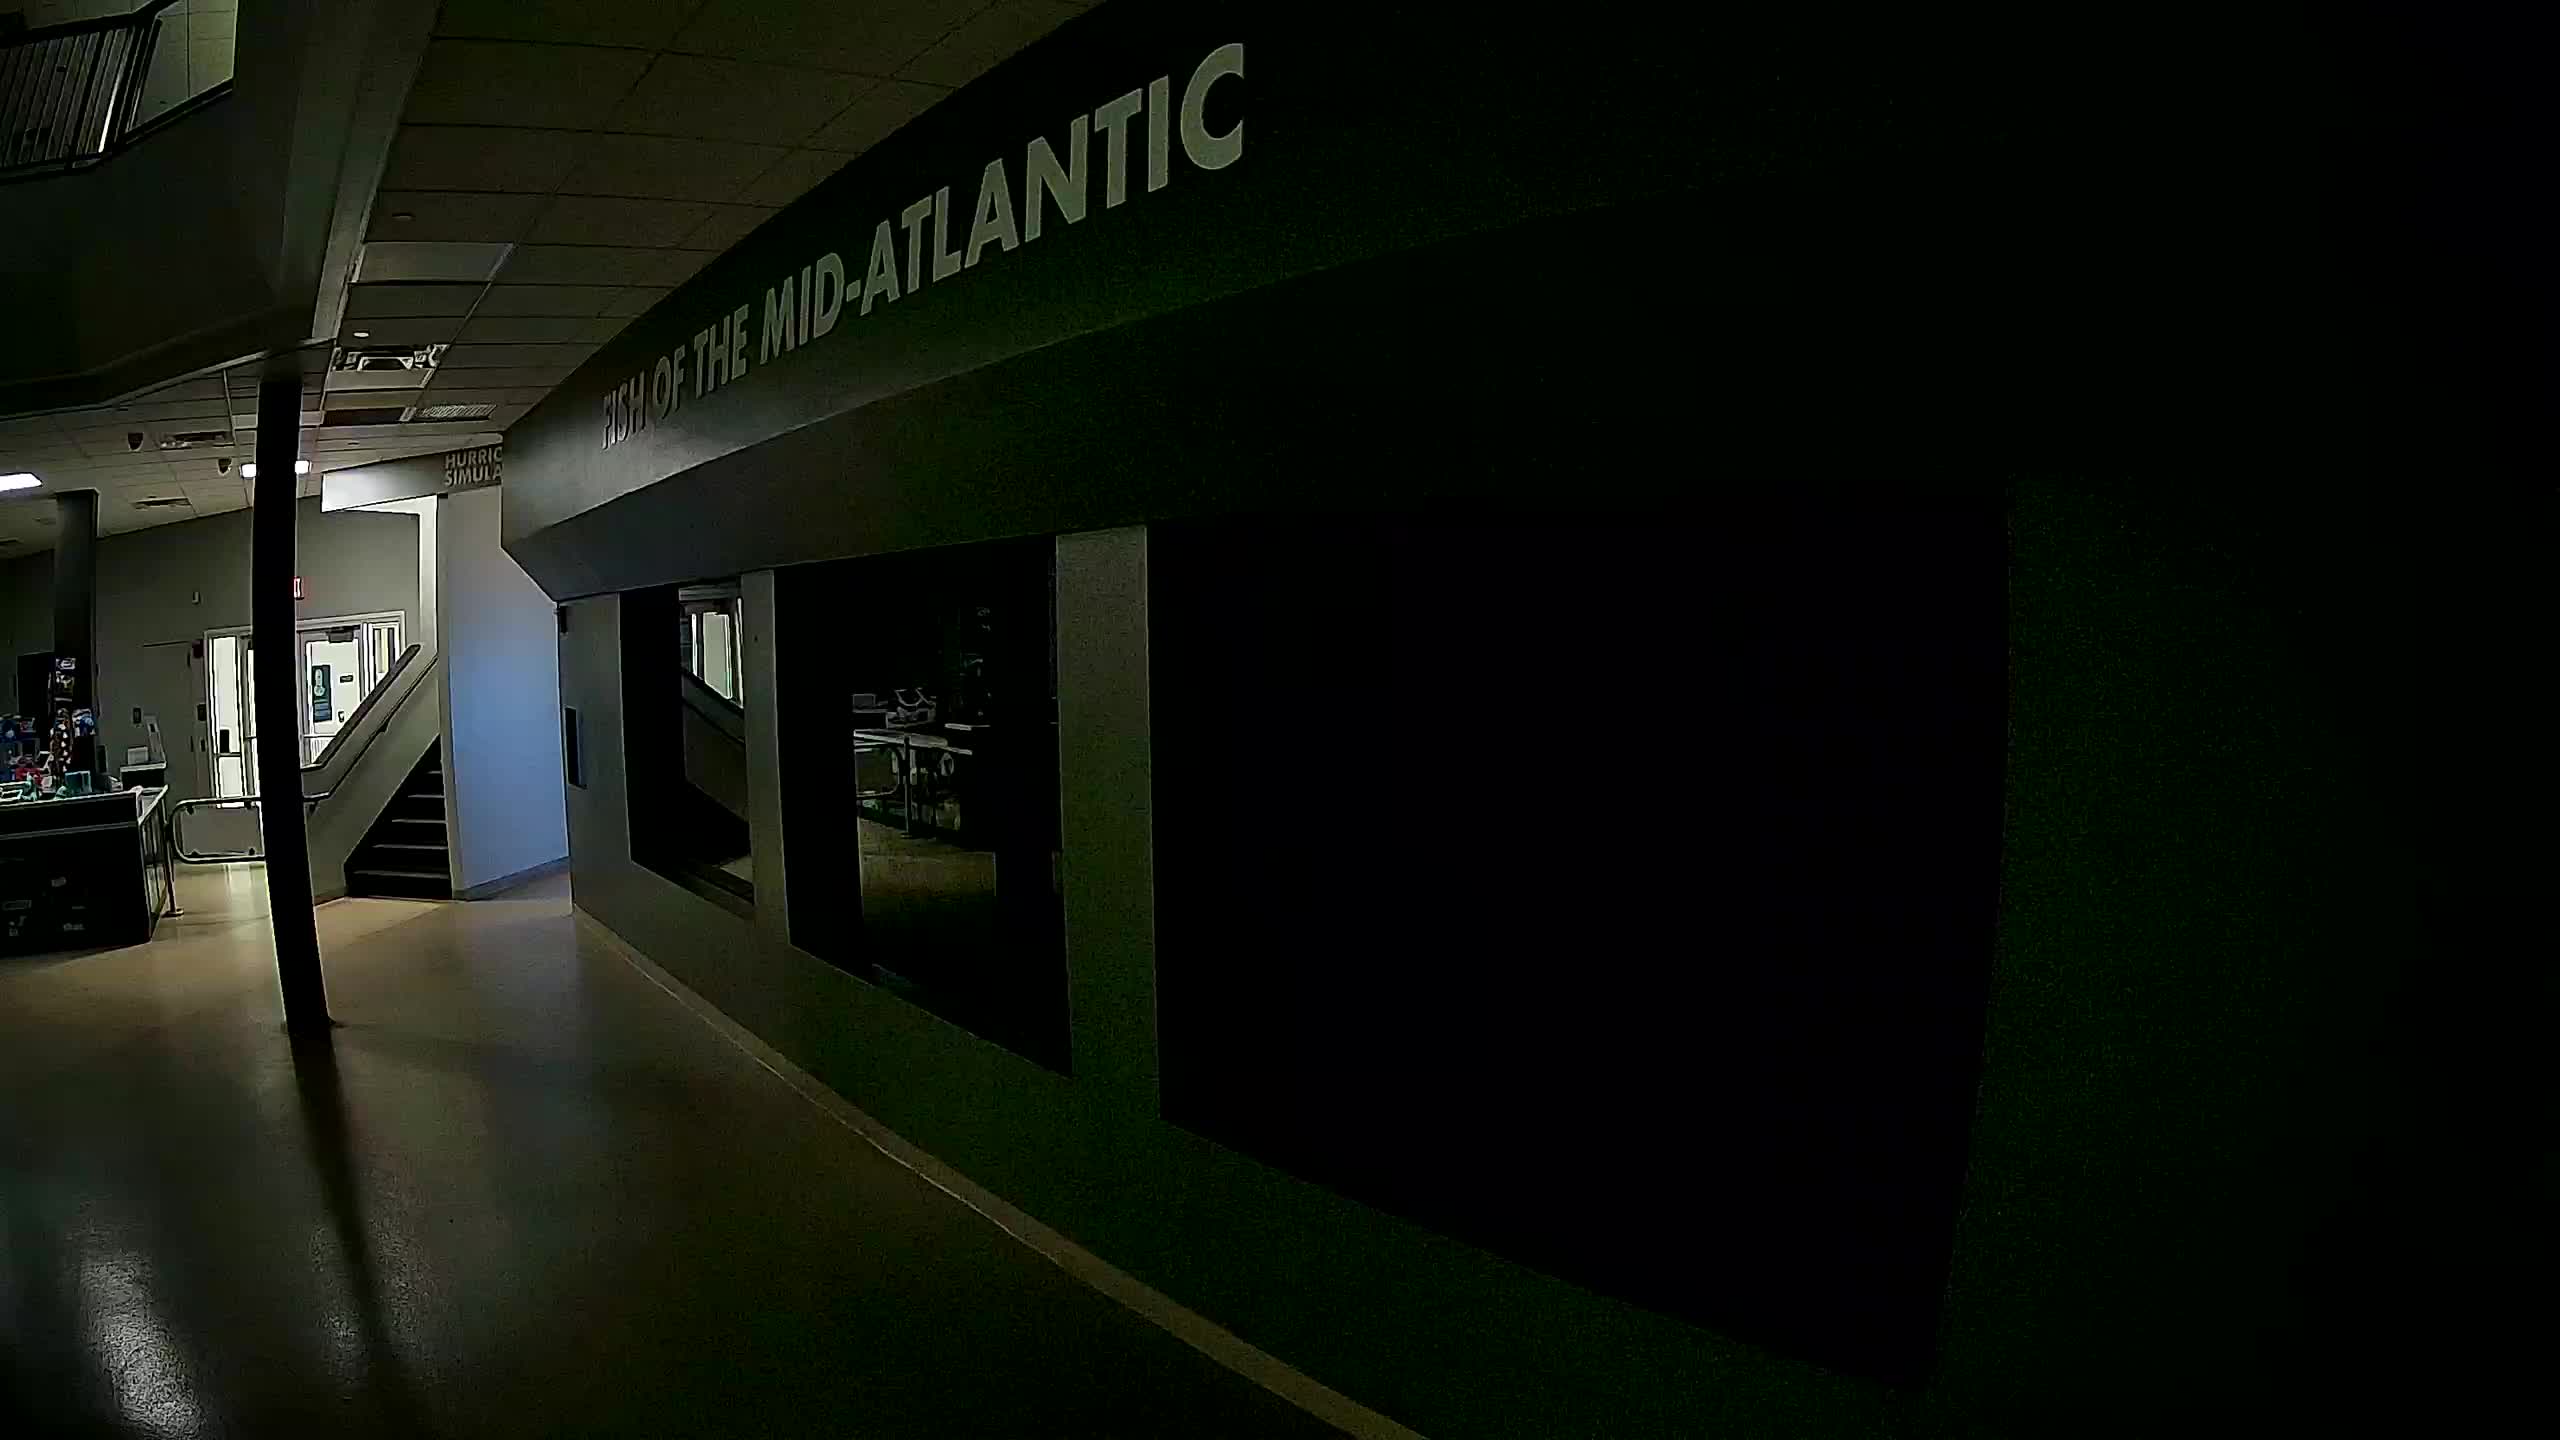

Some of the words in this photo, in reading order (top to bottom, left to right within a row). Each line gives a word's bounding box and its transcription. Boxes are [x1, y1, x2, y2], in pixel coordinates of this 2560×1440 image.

[602, 368, 646, 450] FISH
[653, 344, 686, 418] OF
[694, 303, 749, 400] THE
[760, 42, 1244, 366] MID-ATLANTIC
